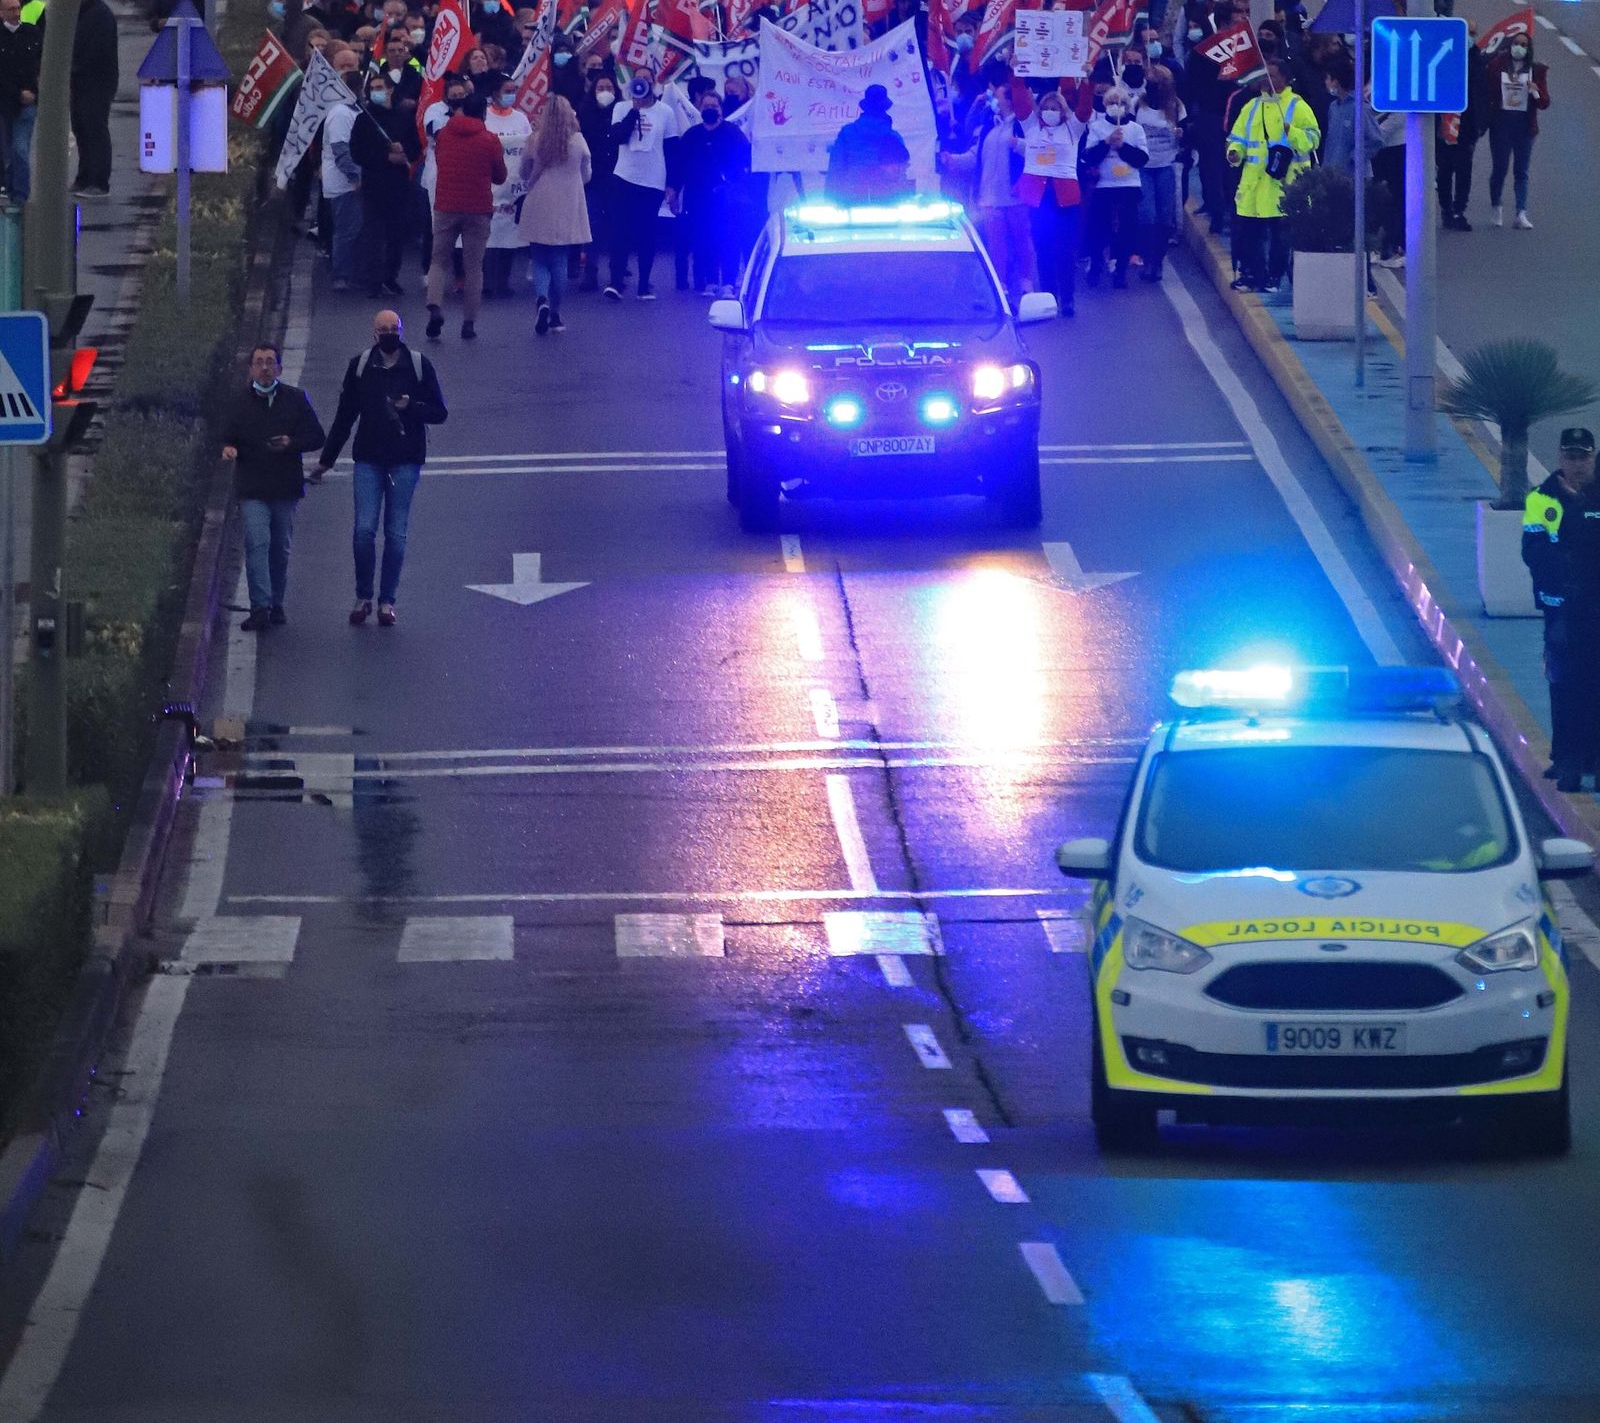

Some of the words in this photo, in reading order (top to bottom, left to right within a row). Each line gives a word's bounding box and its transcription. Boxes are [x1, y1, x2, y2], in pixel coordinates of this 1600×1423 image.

[836, 355, 947, 367] POLICIA
[1284, 1027, 1341, 1050] 9009
[1354, 1027, 1398, 1050] KWZ
